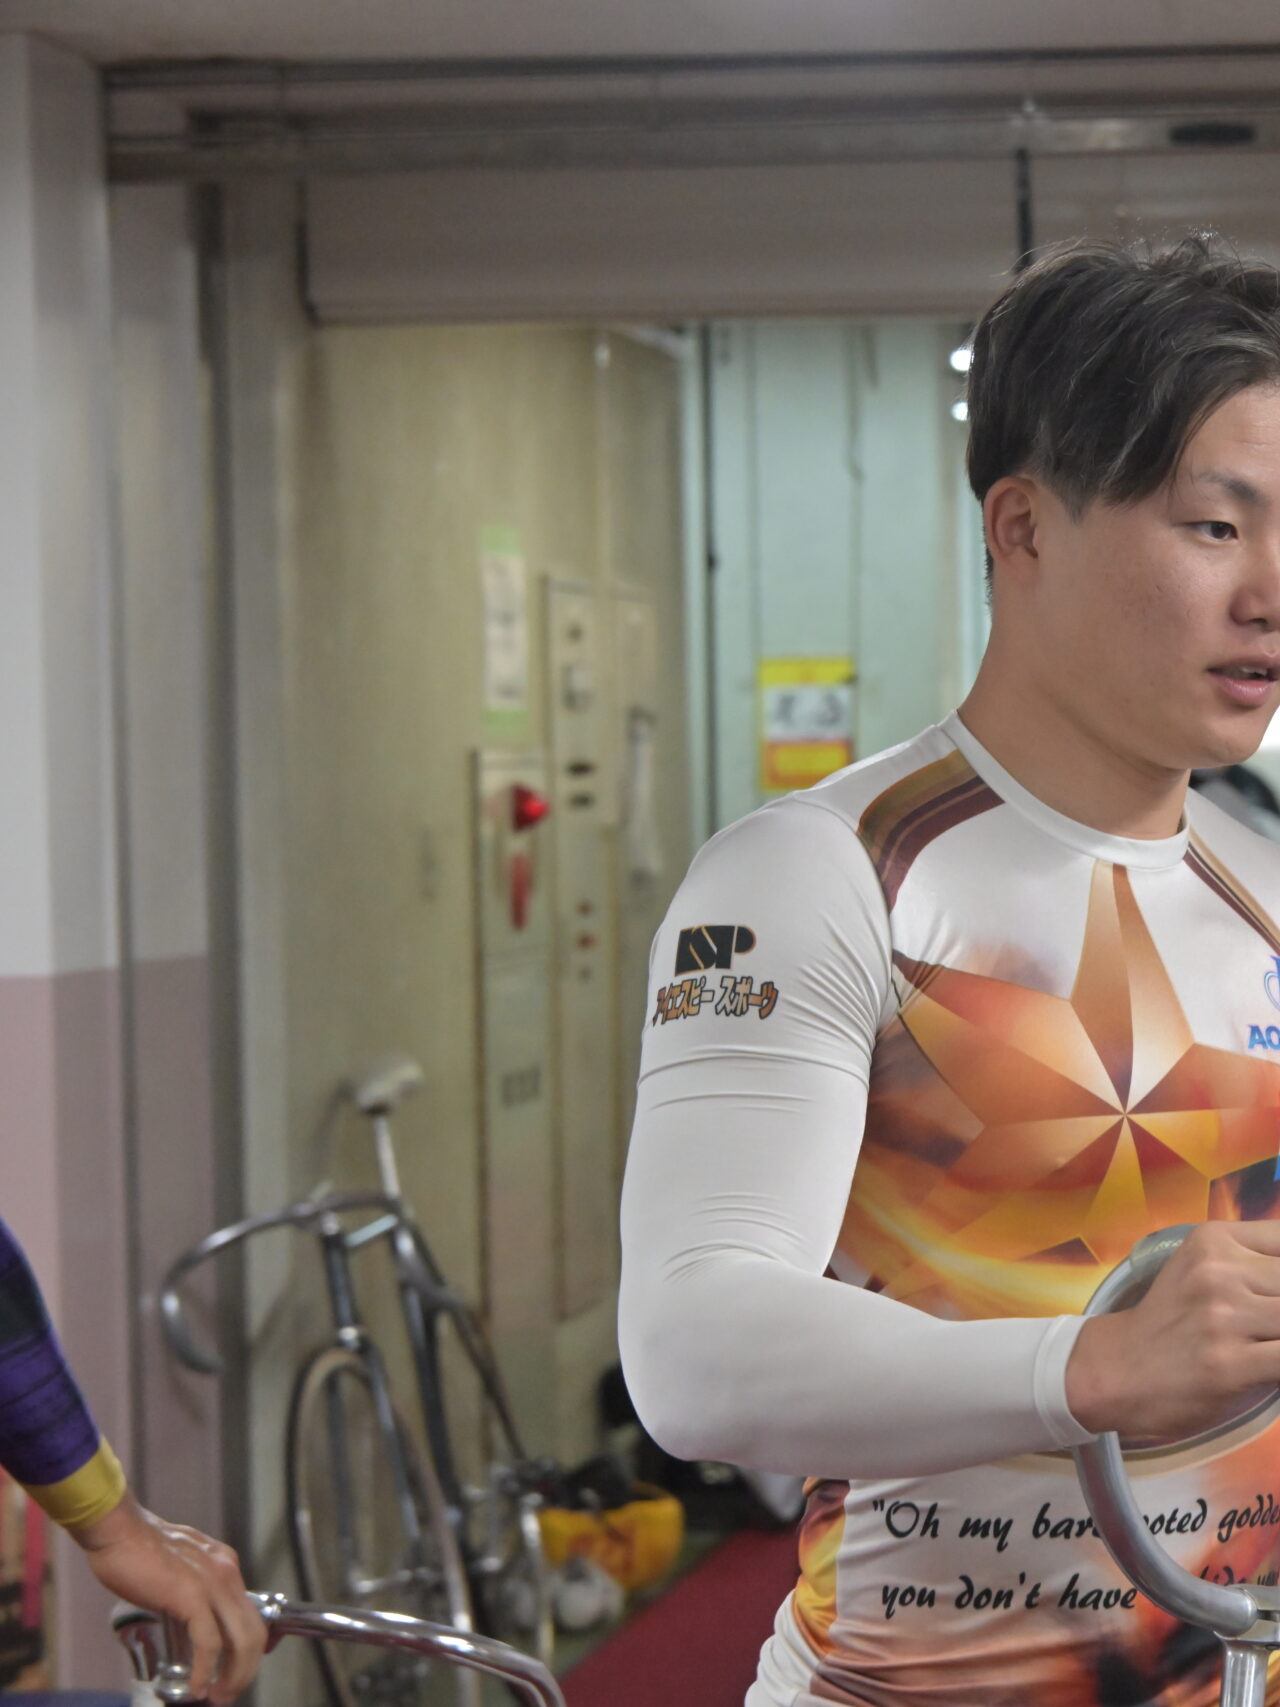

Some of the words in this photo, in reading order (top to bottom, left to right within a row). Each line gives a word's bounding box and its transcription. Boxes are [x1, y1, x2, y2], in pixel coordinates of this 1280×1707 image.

[872, 1499, 939, 1539] "Oh
[958, 1516, 1014, 1553] my
[881, 1584, 936, 1620] you
[955, 1572, 1041, 1610] don't
[1058, 1572, 1138, 1610] have
